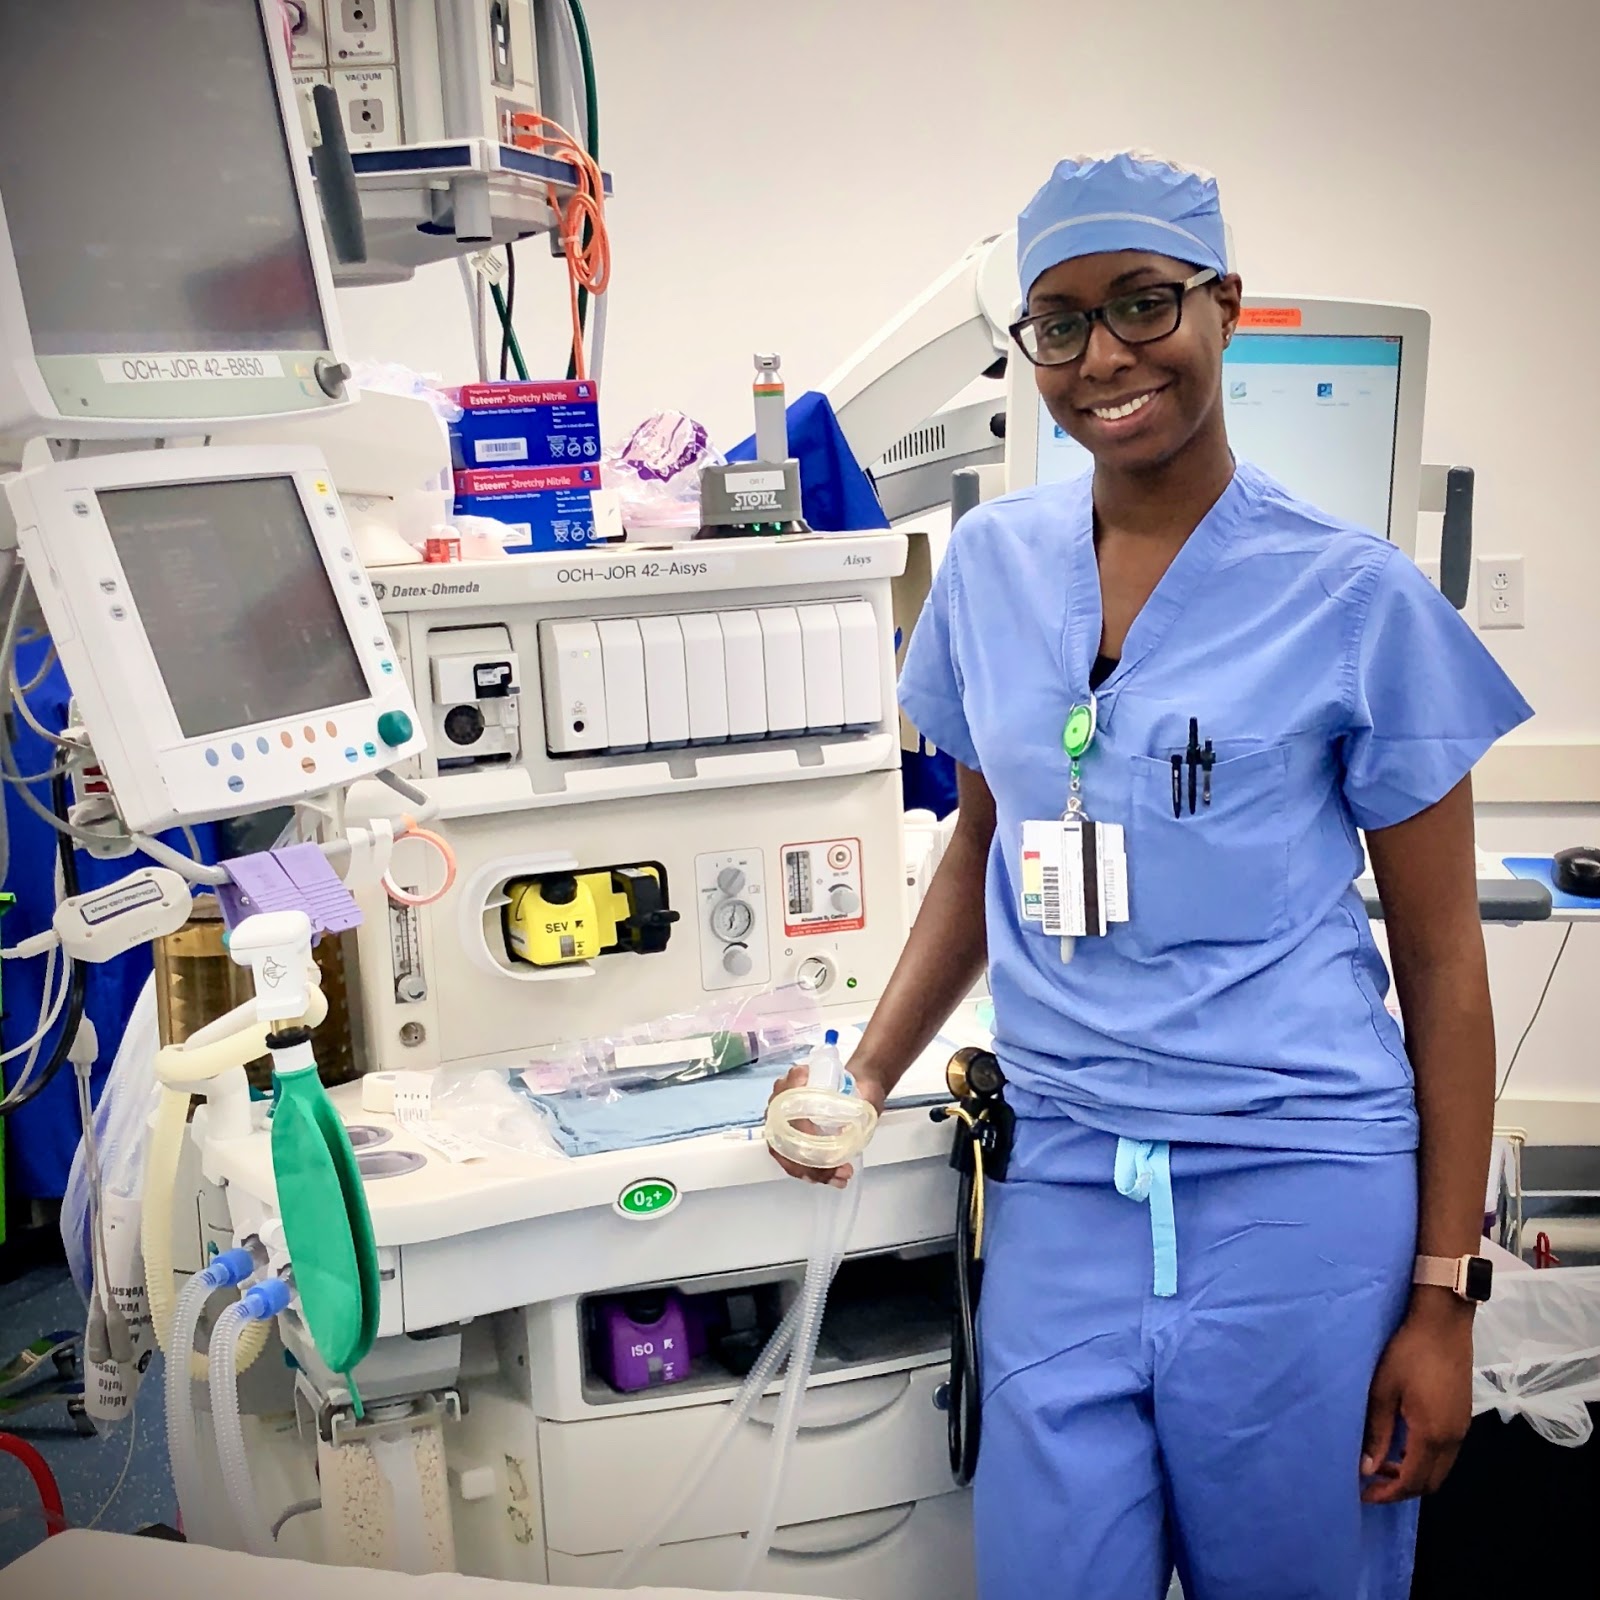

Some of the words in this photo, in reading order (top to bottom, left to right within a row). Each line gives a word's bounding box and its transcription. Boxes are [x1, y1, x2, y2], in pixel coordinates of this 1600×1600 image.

[345, 73, 382, 81] VACUUM
[122, 358, 201, 380] OCH-JOR
[204, 357, 264, 377] 42-B850
[508, 392, 541, 404] Stretchy
[542, 392, 568, 401] Nitrile
[511, 479, 544, 489] Stretchy
[546, 477, 571, 485] Nitrile
[735, 491, 777, 506] STORZ
[843, 554, 872, 566] Aisys
[557, 565, 636, 583] OCH-JOR
[641, 562, 707, 577] 42-Aisys
[392, 582, 480, 598] Datex-Ohmeda
[545, 922, 568, 933] SEV
[631, 1342, 654, 1357] ISO
